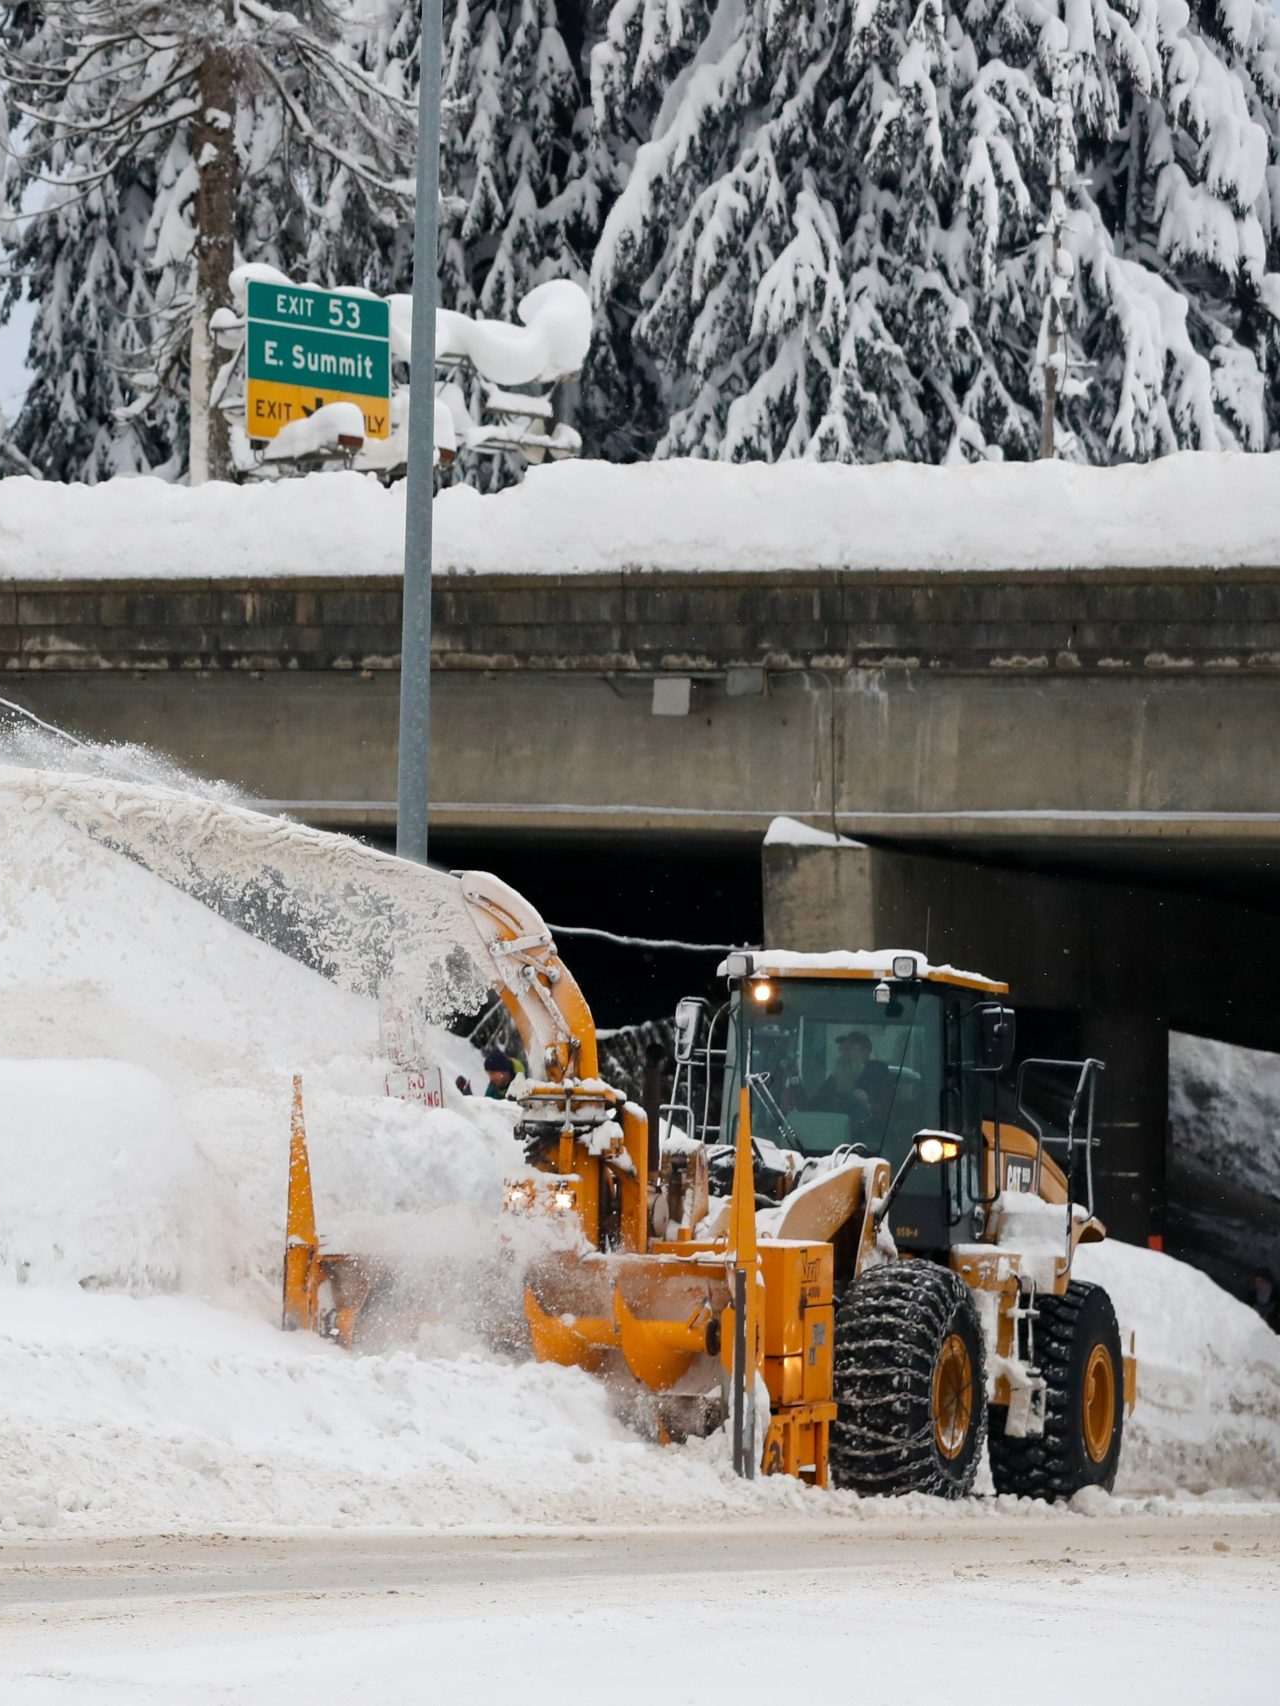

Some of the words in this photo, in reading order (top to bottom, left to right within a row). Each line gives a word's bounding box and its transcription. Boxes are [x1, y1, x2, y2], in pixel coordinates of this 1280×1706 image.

[277, 294, 314, 318] EXIT
[328, 298, 361, 329] 53
[264, 340, 284, 367] E.
[292, 344, 373, 379] Summit
[256, 399, 292, 421] EXIT
